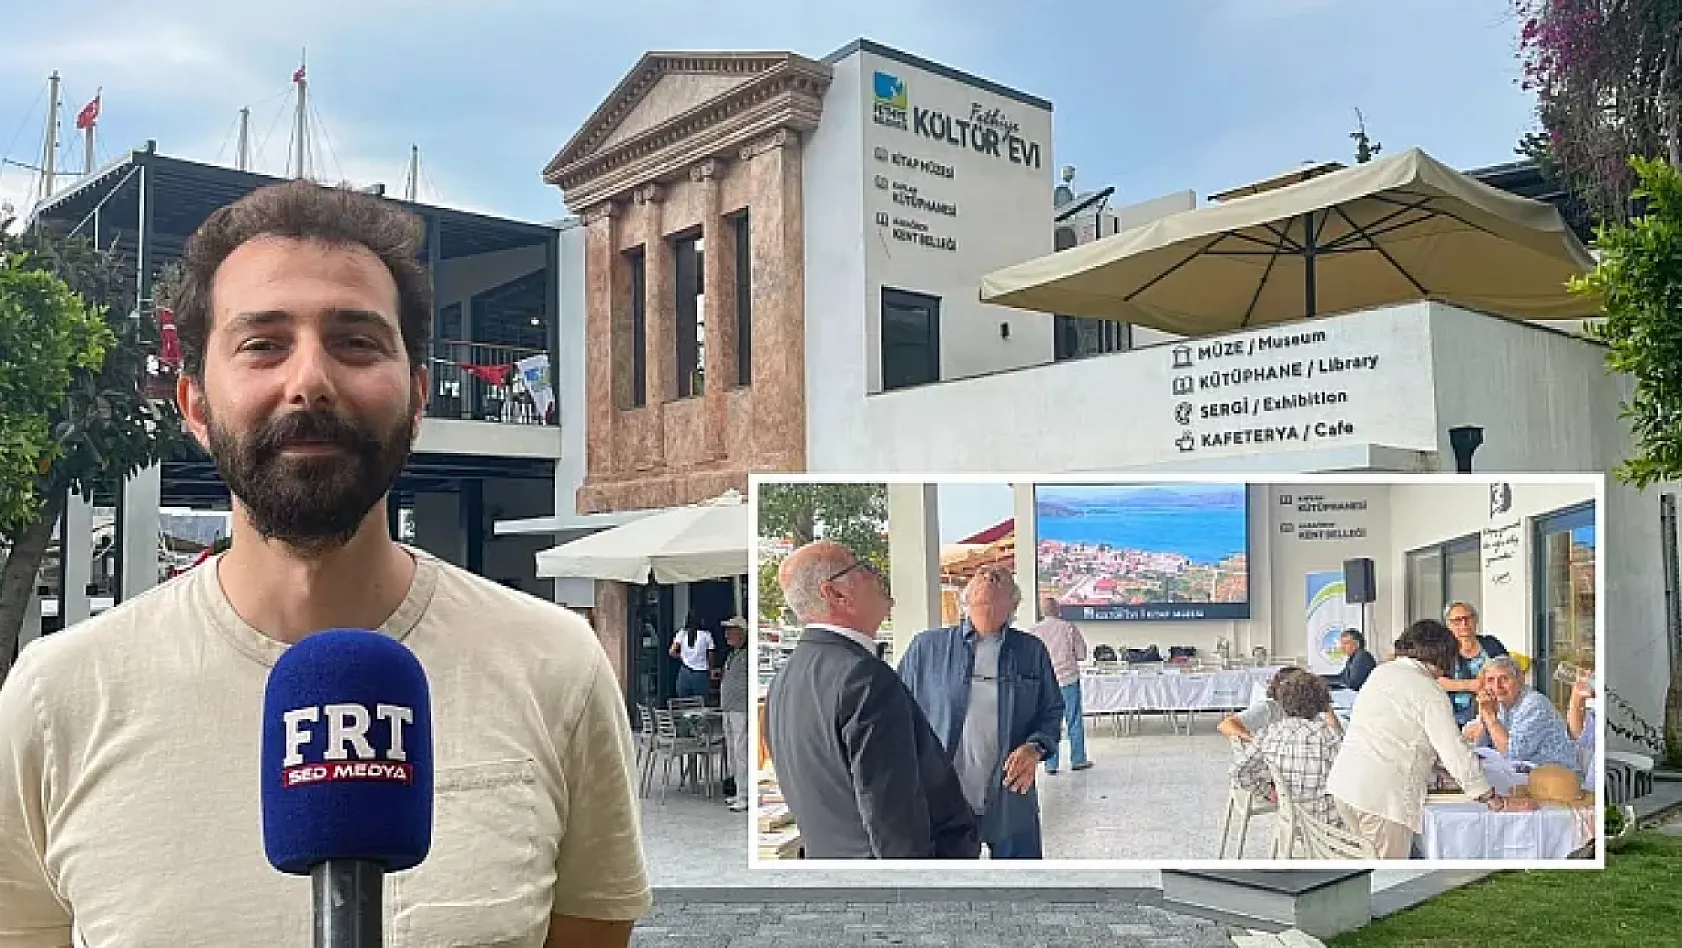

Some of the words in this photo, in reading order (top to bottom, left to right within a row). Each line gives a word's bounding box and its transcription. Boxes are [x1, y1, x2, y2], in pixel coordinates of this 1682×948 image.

[893, 229, 918, 243] KENT
[1198, 341, 1244, 360] MÜZE
[1258, 331, 1326, 350] Museum
[1200, 362, 1302, 389] KÜTÜPHANE
[1319, 354, 1379, 373] Library
[1200, 397, 1249, 419] SERGİ
[1263, 391, 1348, 412] Exhibition
[1201, 425, 1299, 447] KAFETERYA
[1314, 420, 1354, 438] Cafe
[283, 703, 414, 768] FRT
[333, 763, 407, 779] MEDYA
